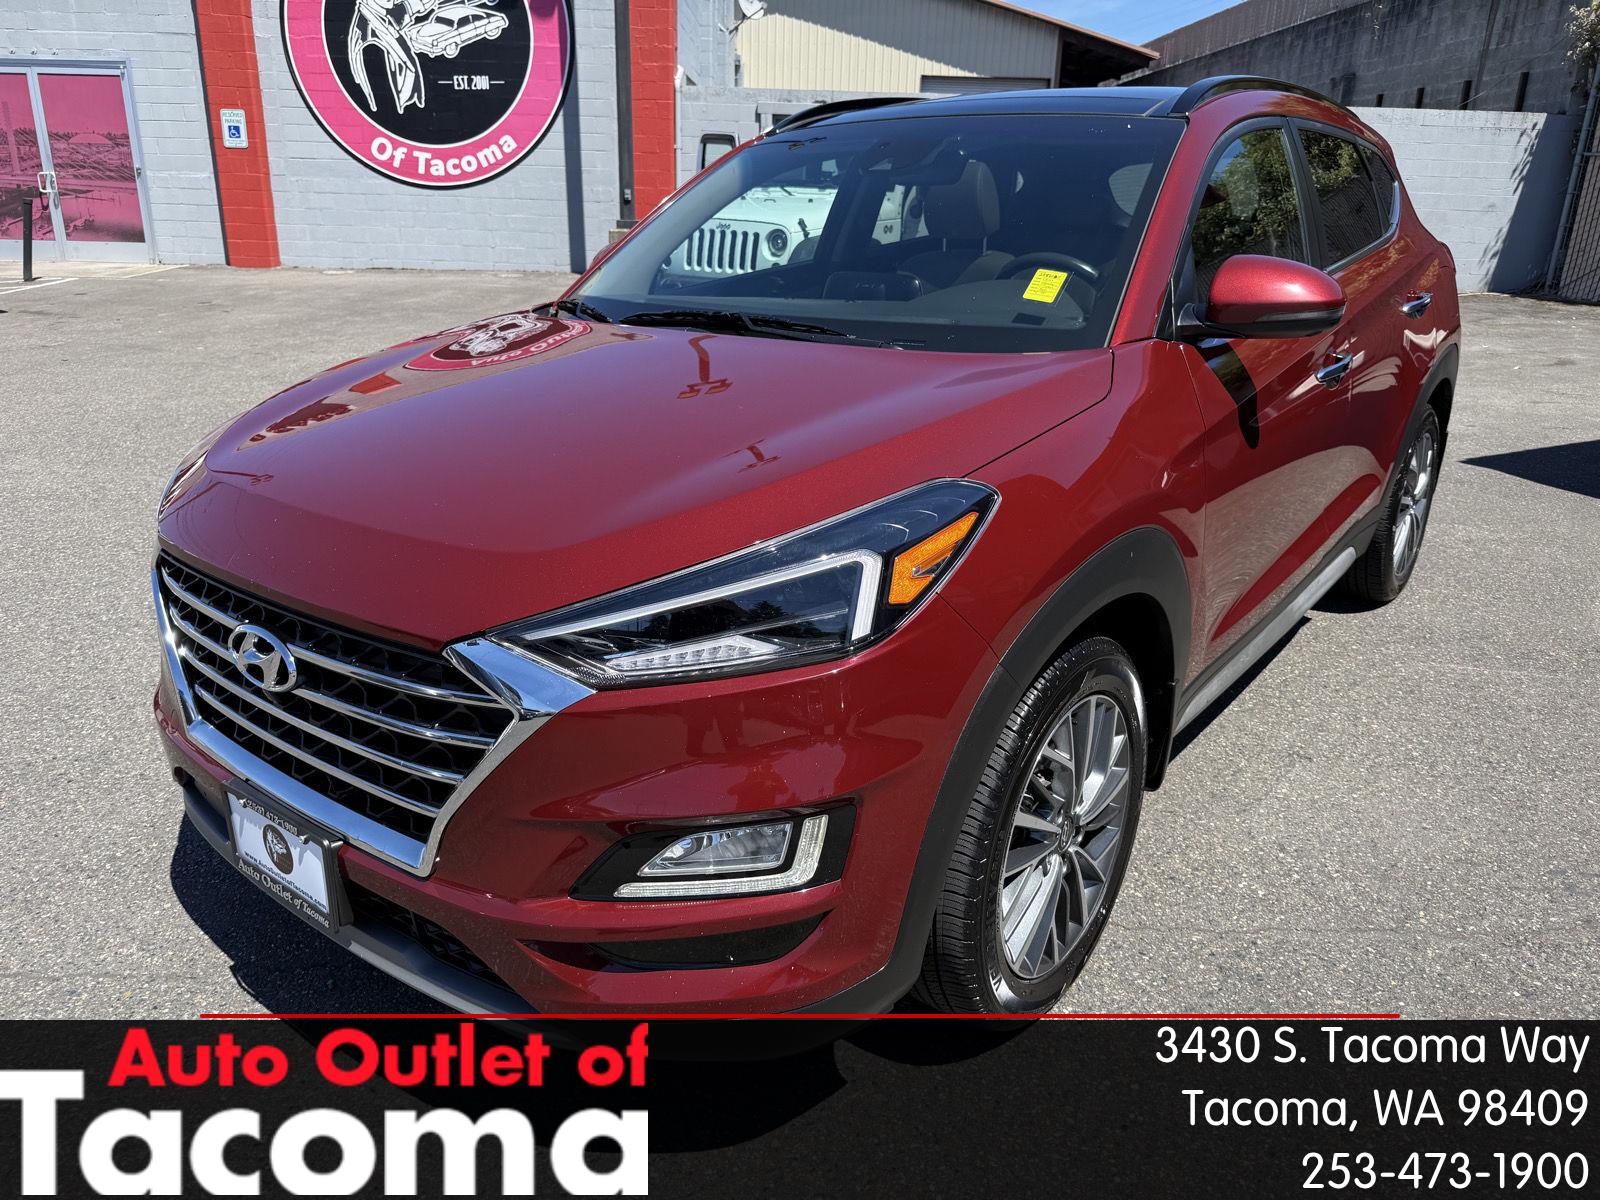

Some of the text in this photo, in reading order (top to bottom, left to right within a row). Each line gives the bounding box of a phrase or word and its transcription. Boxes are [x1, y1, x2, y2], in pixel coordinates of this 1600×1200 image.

[453, 75, 490, 90] EST. 2001
[370, 134, 518, 176] Of Tacoma
[238, 859, 330, 928] Auto Outlet of Tacoma
